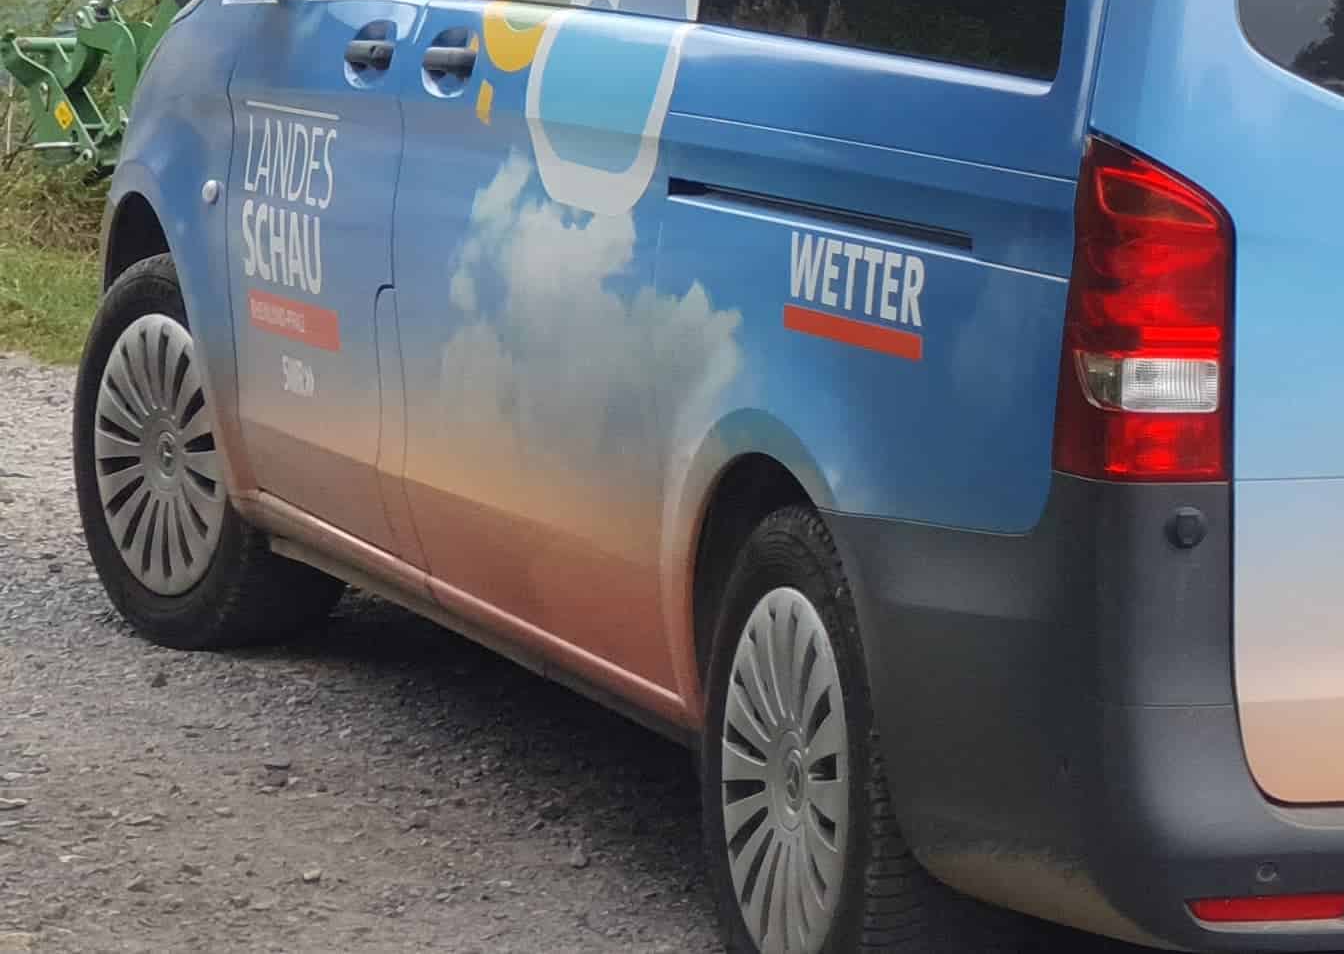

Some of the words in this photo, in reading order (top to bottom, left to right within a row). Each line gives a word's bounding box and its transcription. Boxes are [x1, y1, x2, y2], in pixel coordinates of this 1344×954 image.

[244, 114, 338, 209] LANDES
[242, 199, 321, 295] SCHAU
[790, 230, 925, 327] WETTER
